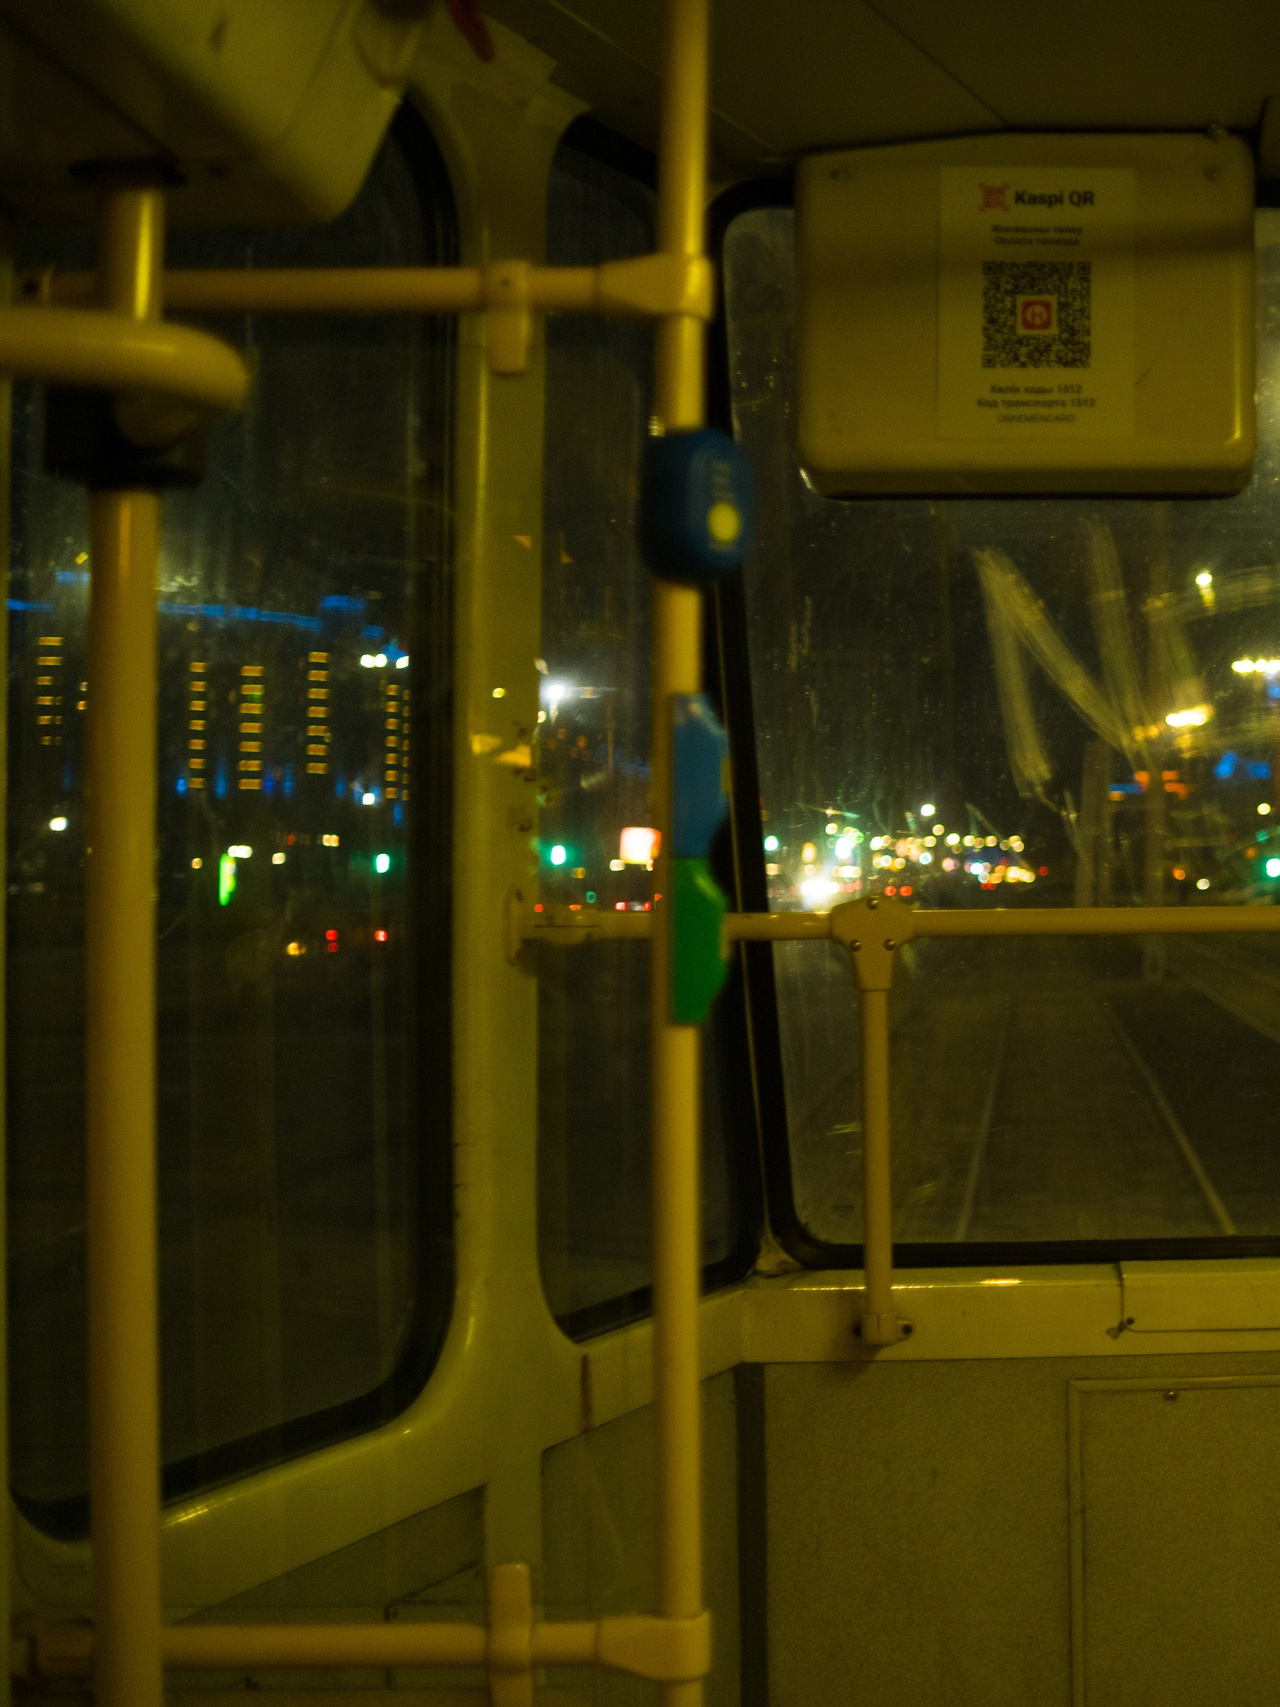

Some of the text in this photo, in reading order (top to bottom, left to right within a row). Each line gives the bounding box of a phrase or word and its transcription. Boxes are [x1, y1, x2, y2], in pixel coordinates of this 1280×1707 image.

[1015, 190, 1096, 209] Kaspi QR
[1057, 384, 1084, 395] 1512
[976, 397, 1096, 409] Код транспорта 1512
